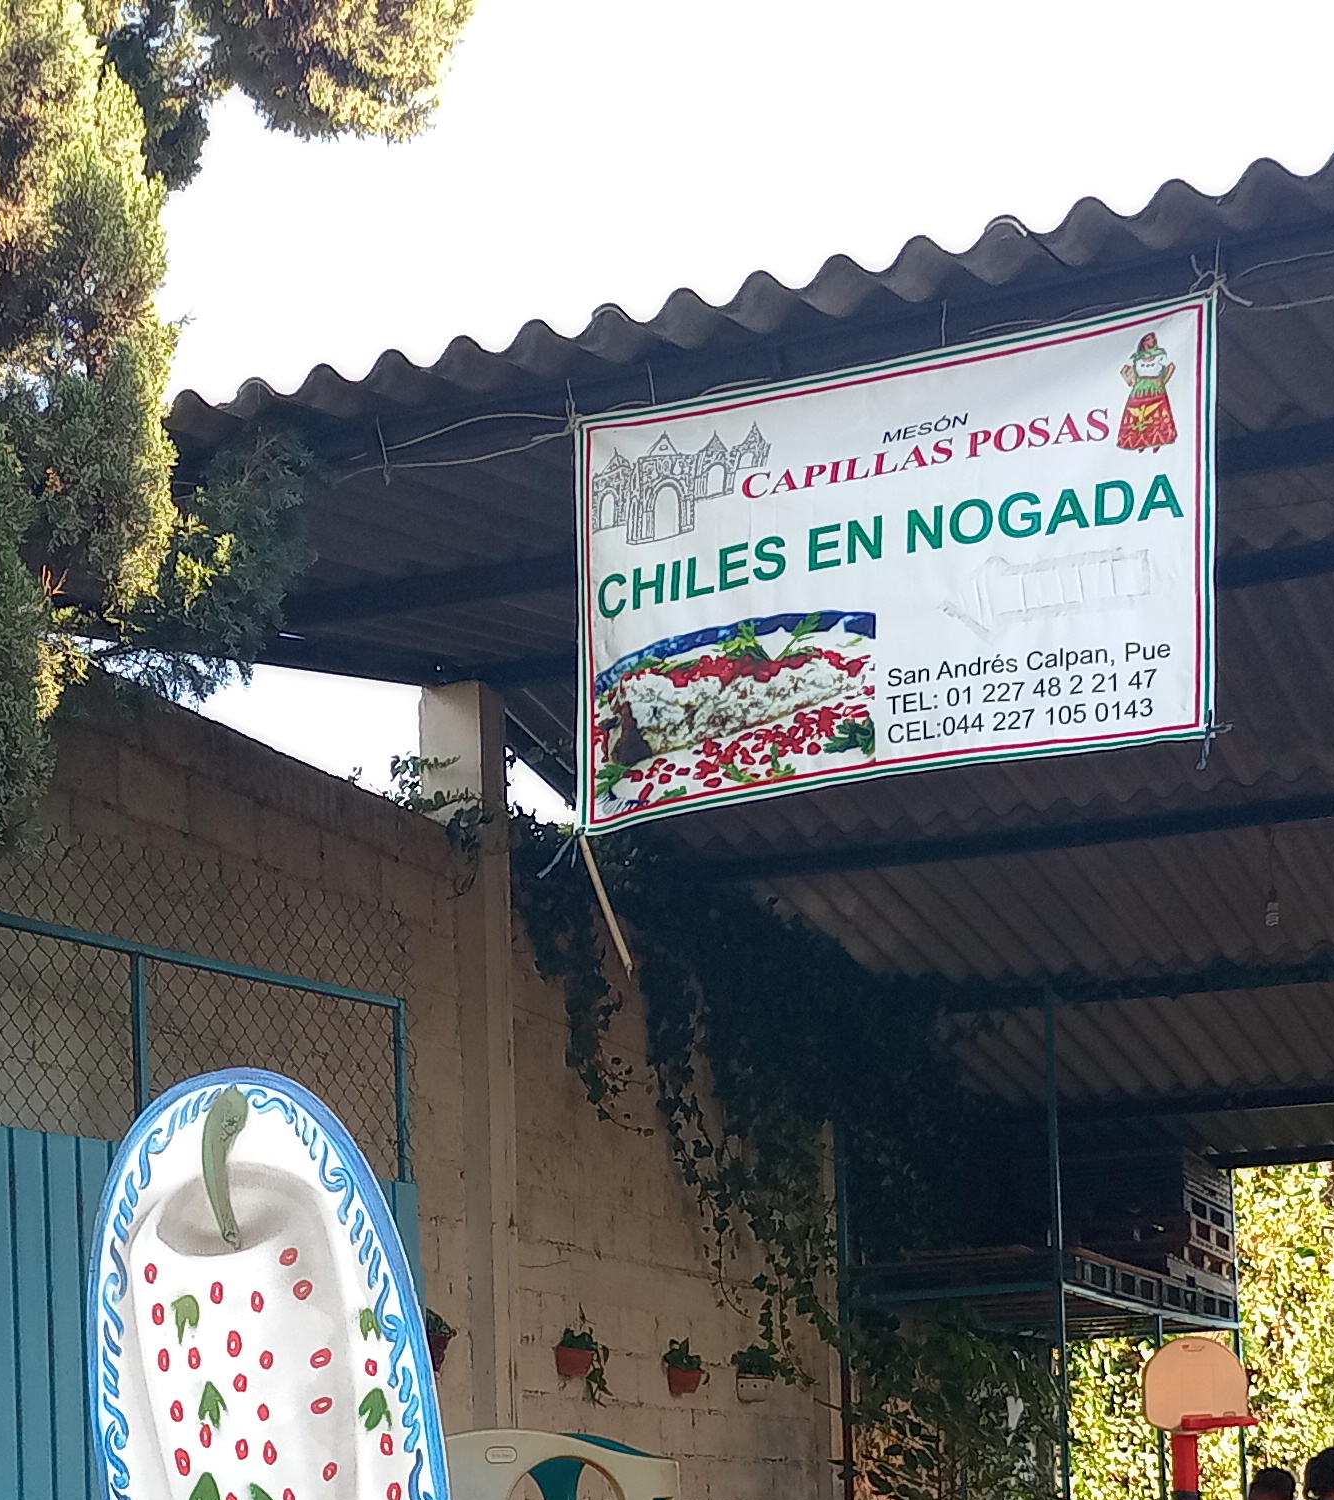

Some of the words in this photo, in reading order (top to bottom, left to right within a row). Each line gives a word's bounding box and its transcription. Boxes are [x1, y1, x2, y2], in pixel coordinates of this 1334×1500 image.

[881, 412, 968, 444] MESÓN
[740, 437, 954, 500] CAPILLAS
[965, 408, 1110, 459] POSAS
[597, 535, 787, 619] CHILES
[808, 515, 883, 572] EN
[905, 473, 1185, 554] NOGADA
[886, 667, 930, 687] San
[936, 654, 1018, 681] Andrés
[1026, 648, 1115, 672] Calpan,
[1125, 641, 1171, 663] Pue
[886, 691, 939, 715] TEL:
[946, 686, 972, 708] 01
[982, 681, 1025, 704] 227
[1033, 677, 1062, 698] 48
[1069, 675, 1083, 694] 2
[1091, 672, 1118, 693] 21
[1128, 668, 1157, 690] 47
[887, 713, 984, 744] CEL:044
[993, 709, 1035, 731] 227
[1045, 703, 1087, 726] 105
[1095, 698, 1154, 722] 0143
